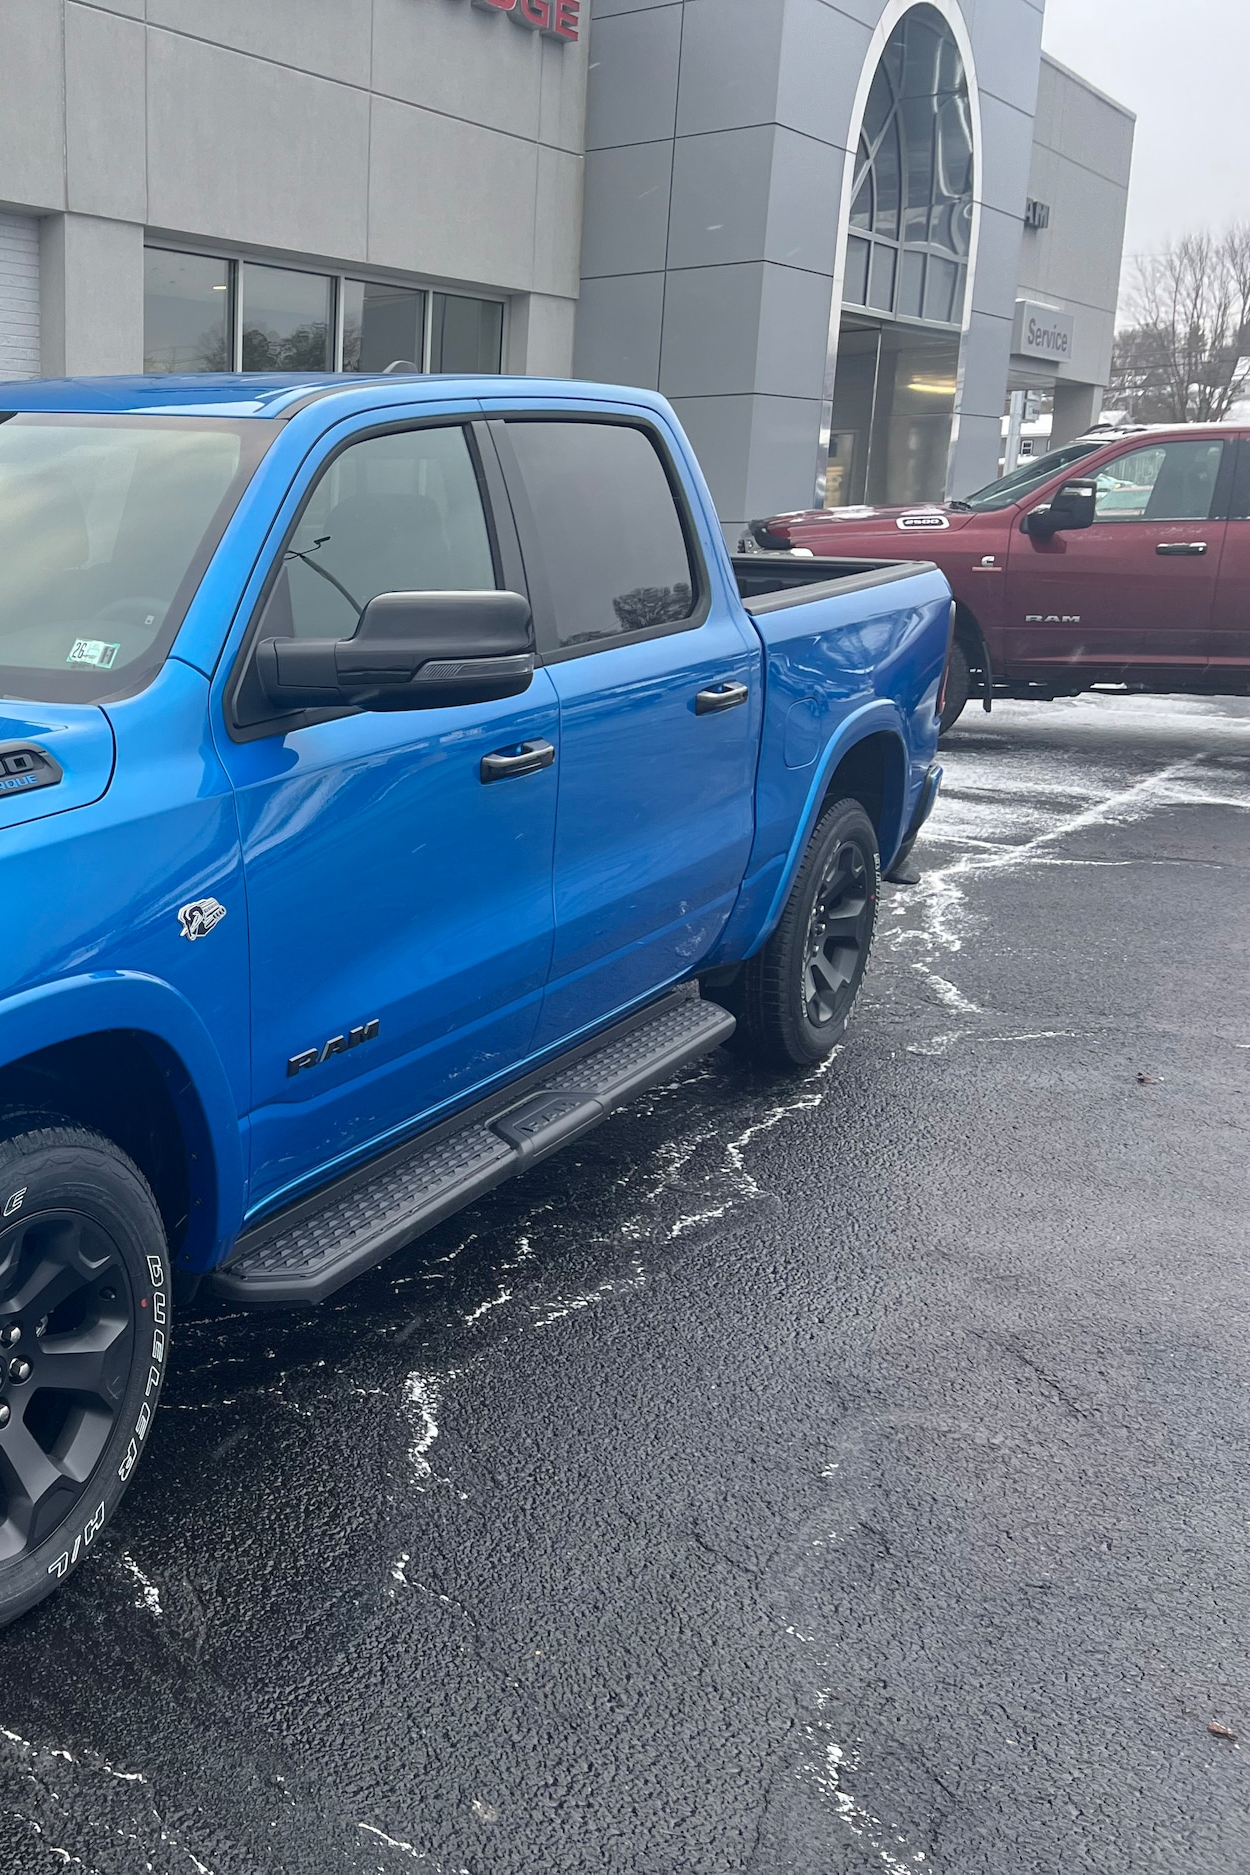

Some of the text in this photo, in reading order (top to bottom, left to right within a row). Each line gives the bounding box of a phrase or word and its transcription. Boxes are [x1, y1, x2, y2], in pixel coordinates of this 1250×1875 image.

[486, 0, 580, 41] GE
[1027, 317, 1068, 353] Service
[1025, 614, 1081, 623] RAM
[71, 642, 88, 659] 26
[287, 1018, 380, 1078] RAM
[47, 1254, 167, 1578] DUELER H/L
